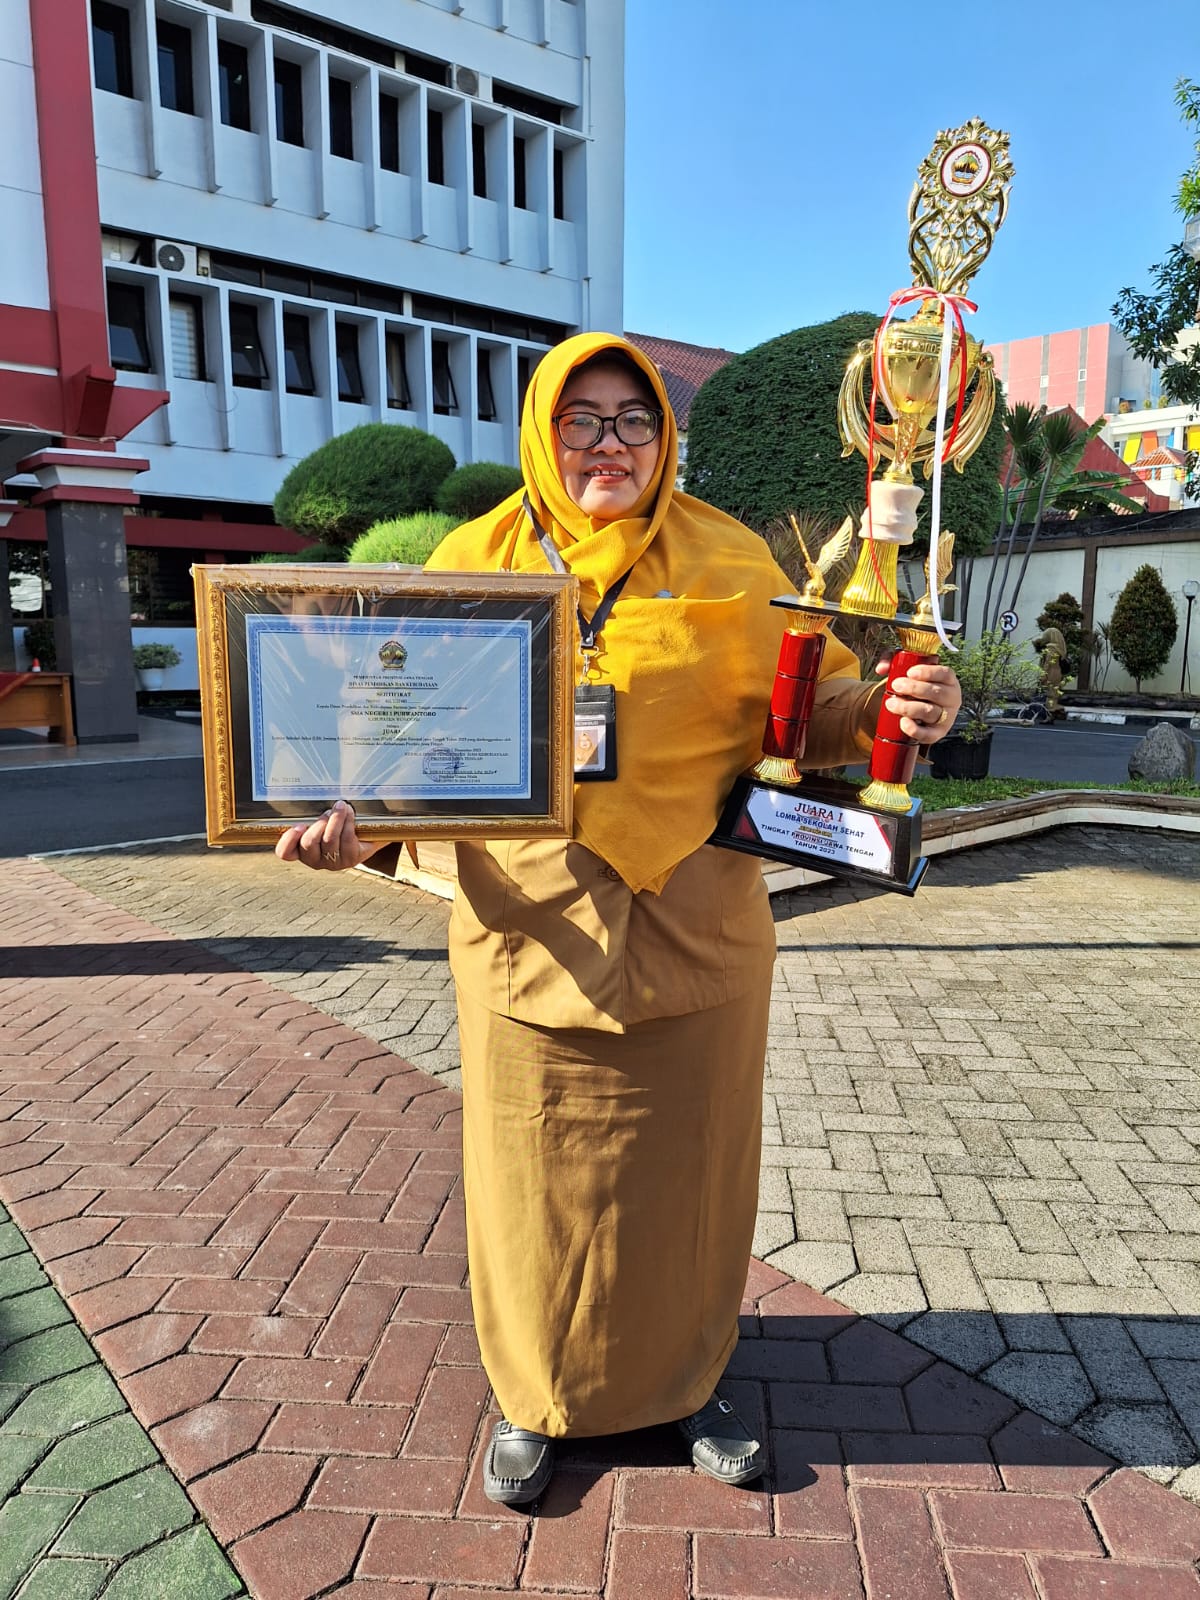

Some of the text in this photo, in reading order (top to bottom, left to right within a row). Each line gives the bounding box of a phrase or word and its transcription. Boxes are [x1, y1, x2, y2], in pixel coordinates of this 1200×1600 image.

[775, 811, 801, 823] LOMBA
[802, 817, 838, 832] SEKOLAH
[840, 826, 865, 838] SEHAT
[794, 802, 844, 823] JUARA I
[761, 824, 790, 835] TINGKAT
[791, 831, 823, 845] PROVINSI
[824, 840, 843, 849] JAWA
[846, 845, 874, 857] TENGAH
[794, 840, 835, 855] TAHUN 2023
